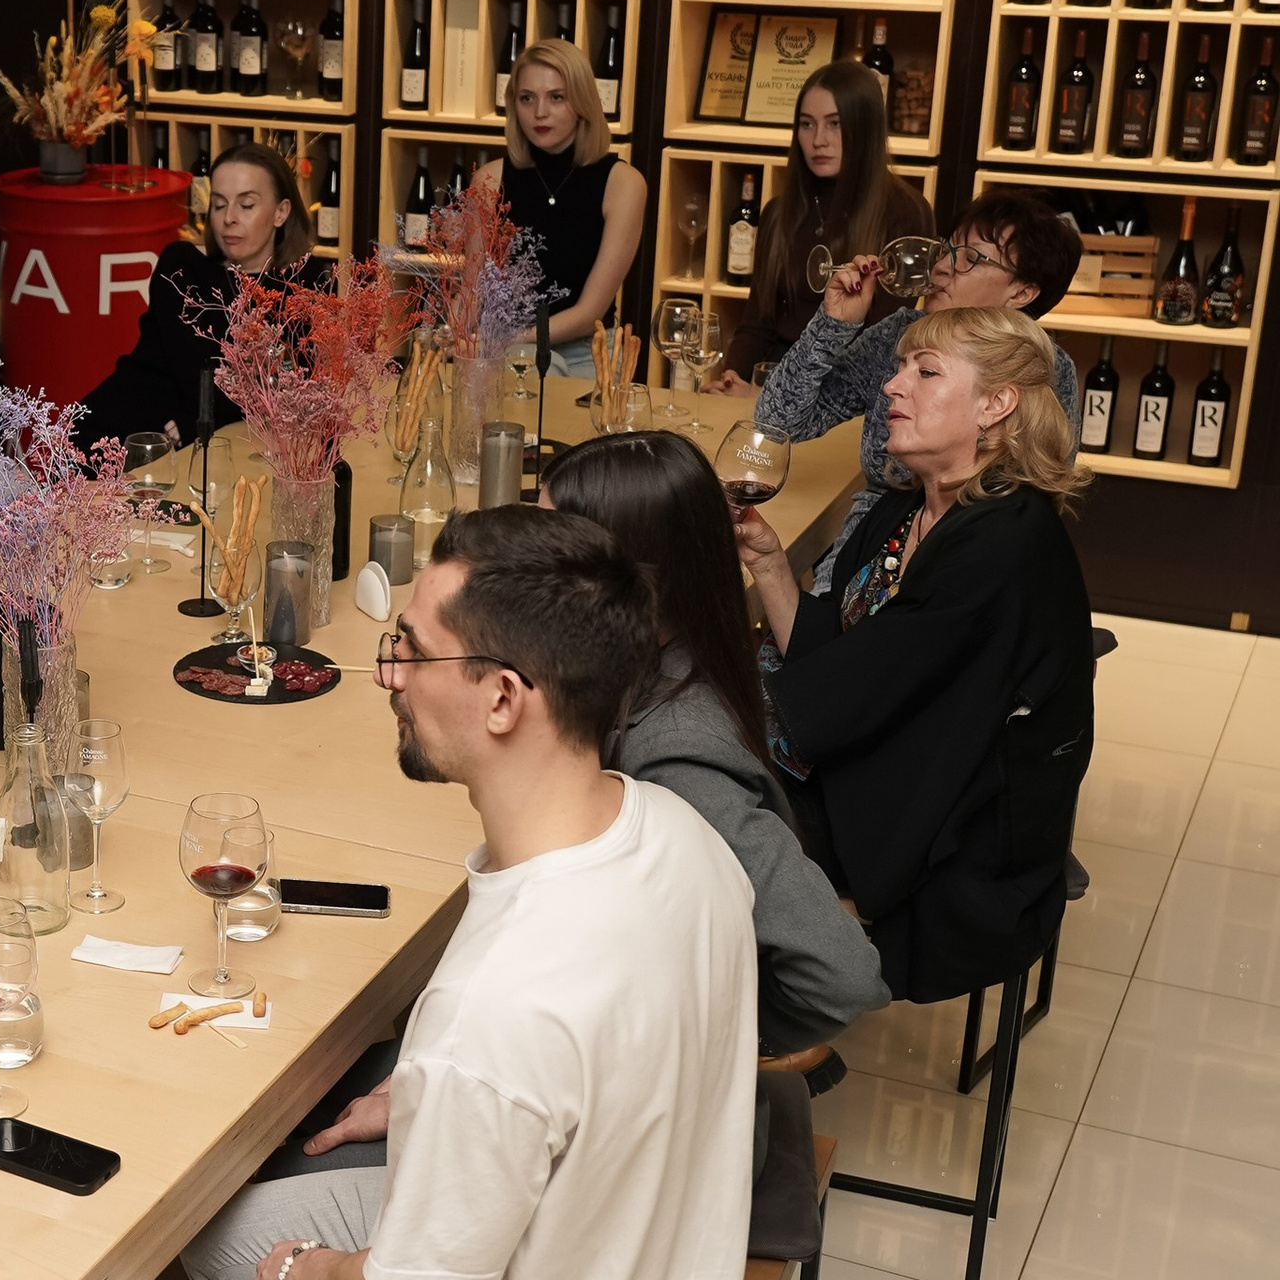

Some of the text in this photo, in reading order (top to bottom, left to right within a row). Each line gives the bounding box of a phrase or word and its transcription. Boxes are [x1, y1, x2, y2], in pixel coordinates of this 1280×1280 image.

[707, 71, 745, 82] КУБАНЬ
[756, 81, 782, 90] ШАТО
[0, 240, 157, 315] AR
[1088, 394, 1105, 416] R
[1143, 400, 1160, 422] R
[1200, 406, 1218, 428] R
[736, 449, 774, 466] TAMAGNE
